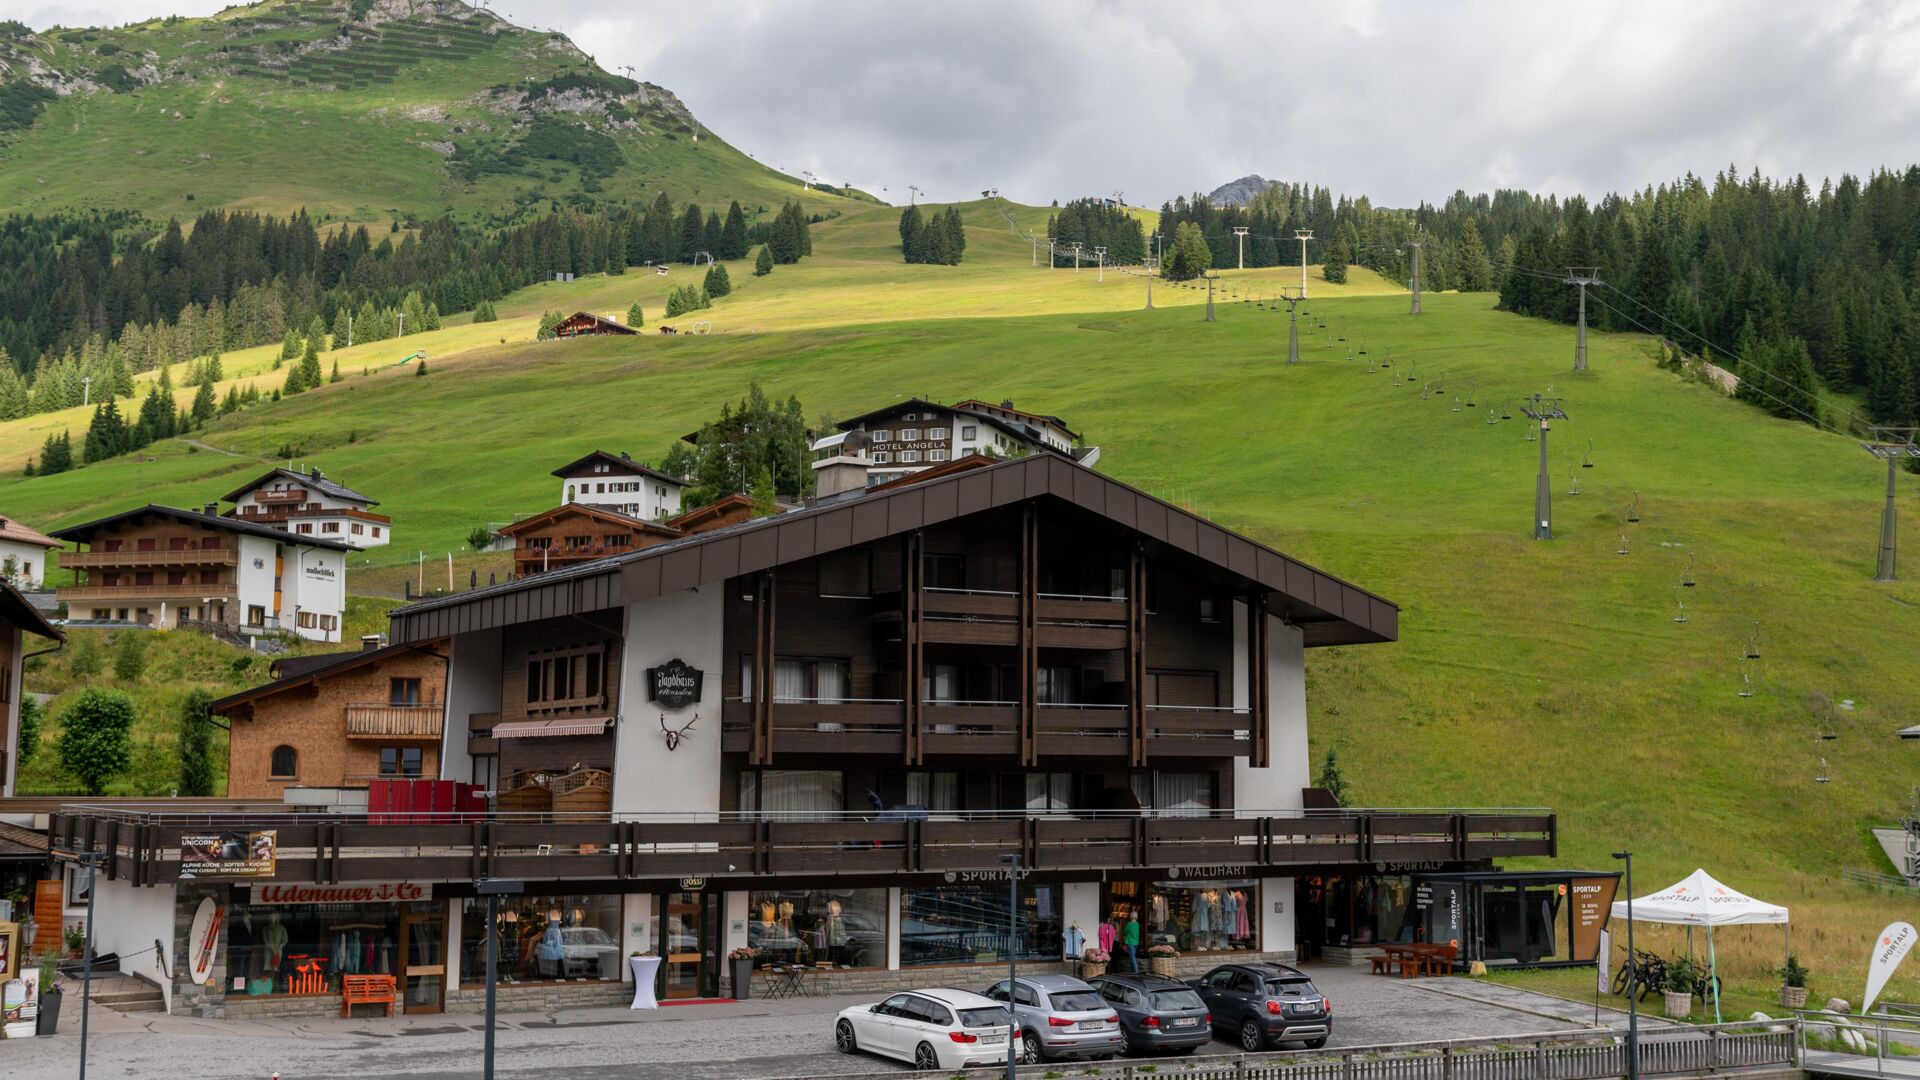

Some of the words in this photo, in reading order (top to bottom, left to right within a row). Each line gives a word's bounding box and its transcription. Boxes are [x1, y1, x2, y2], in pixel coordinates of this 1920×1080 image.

[872, 443, 903, 451] HOTEL
[906, 441, 946, 449] ANGELA
[657, 671, 695, 688] Jagdhaus
[1183, 865, 1247, 877] WALDHART
[1390, 861, 1444, 871] SPORTALP
[396, 882, 424, 900] Co
[1572, 885, 1602, 893] SPORTALP
[1649, 895, 1701, 903] SPORTALP
[1709, 896, 1751, 904] SPORTALP
[1880, 927, 1909, 965] SPORTALP
